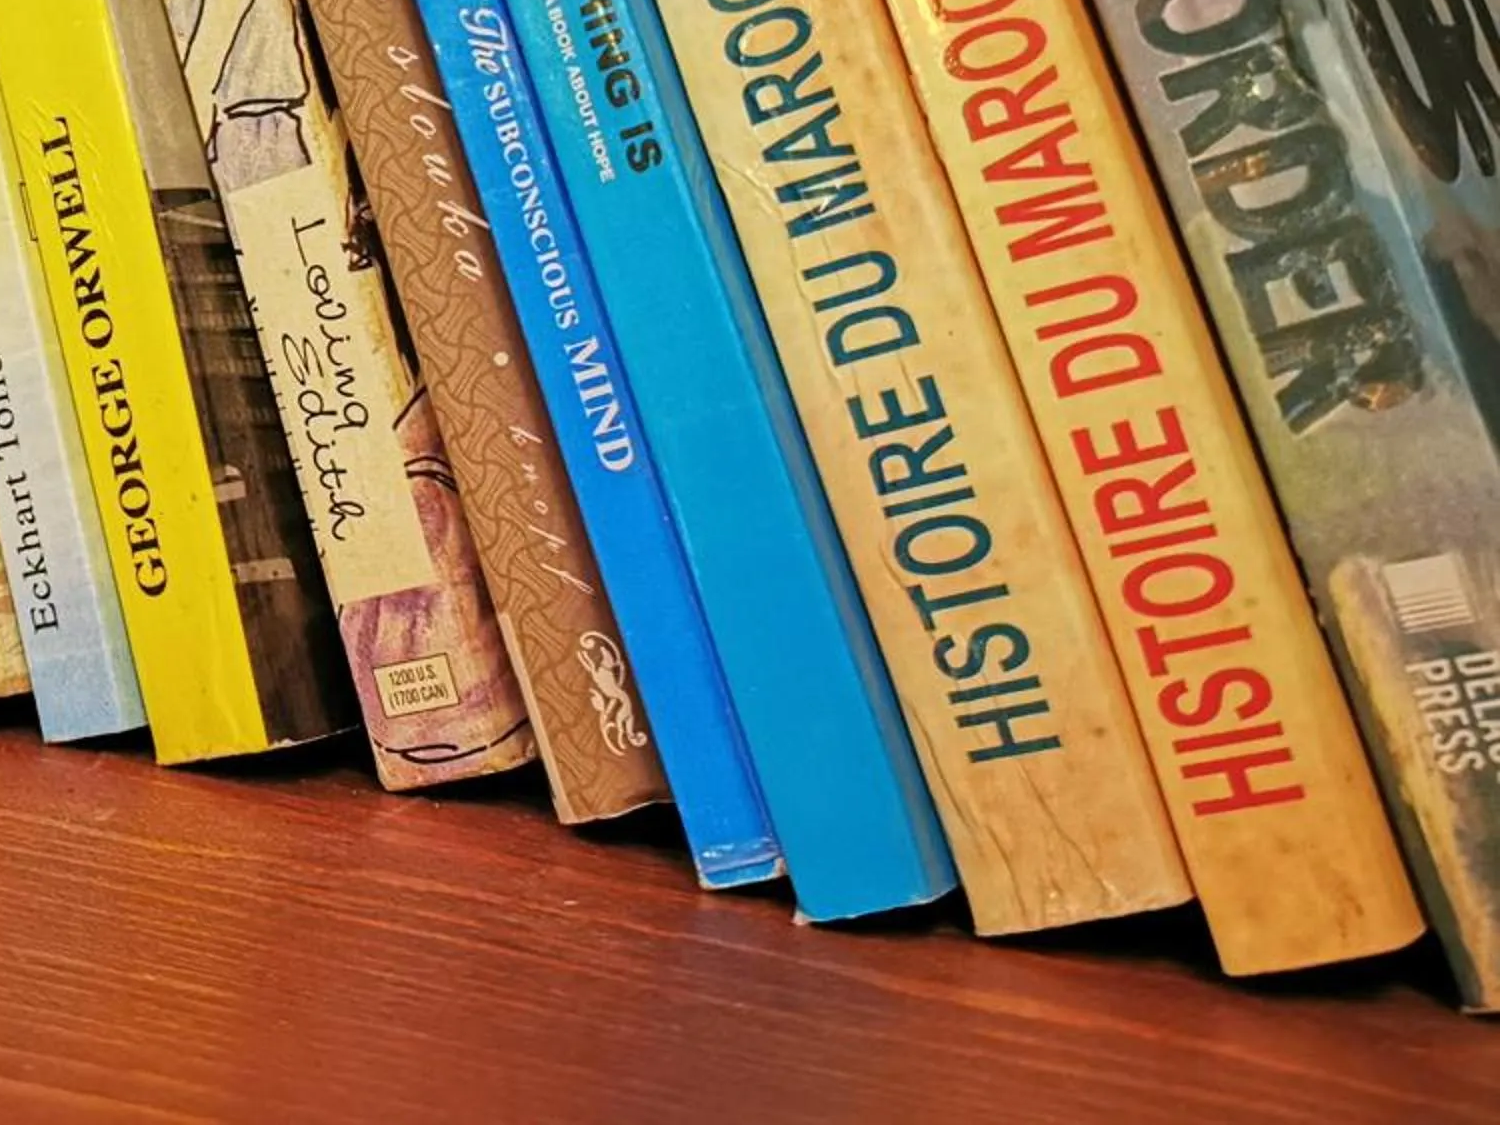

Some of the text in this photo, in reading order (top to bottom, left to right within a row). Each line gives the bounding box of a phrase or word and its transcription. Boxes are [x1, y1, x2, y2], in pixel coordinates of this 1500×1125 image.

[459, 5, 509, 76] The
[547, 7, 576, 68] BOOK
[567, 67, 597, 130] ABOUT
[588, 130, 617, 186] HOPE
[387, 45, 490, 282] slouka
[483, 78, 580, 331] SUBCONSCIOUS
[618, 121, 665, 175] IS
[40, 116, 168, 598] GEORGE ORWELL
[281, 216, 370, 542] Loving Edith
[802, 248, 922, 369] DU
[1026, 274, 1164, 402] DU
[563, 334, 636, 473] MIND
[5, 470, 60, 635] Eckhart
[846, 373, 1063, 766] HISTOIRE
[1071, 405, 1306, 817] HISTOIRE
[1404, 656, 1487, 774] PRESS
